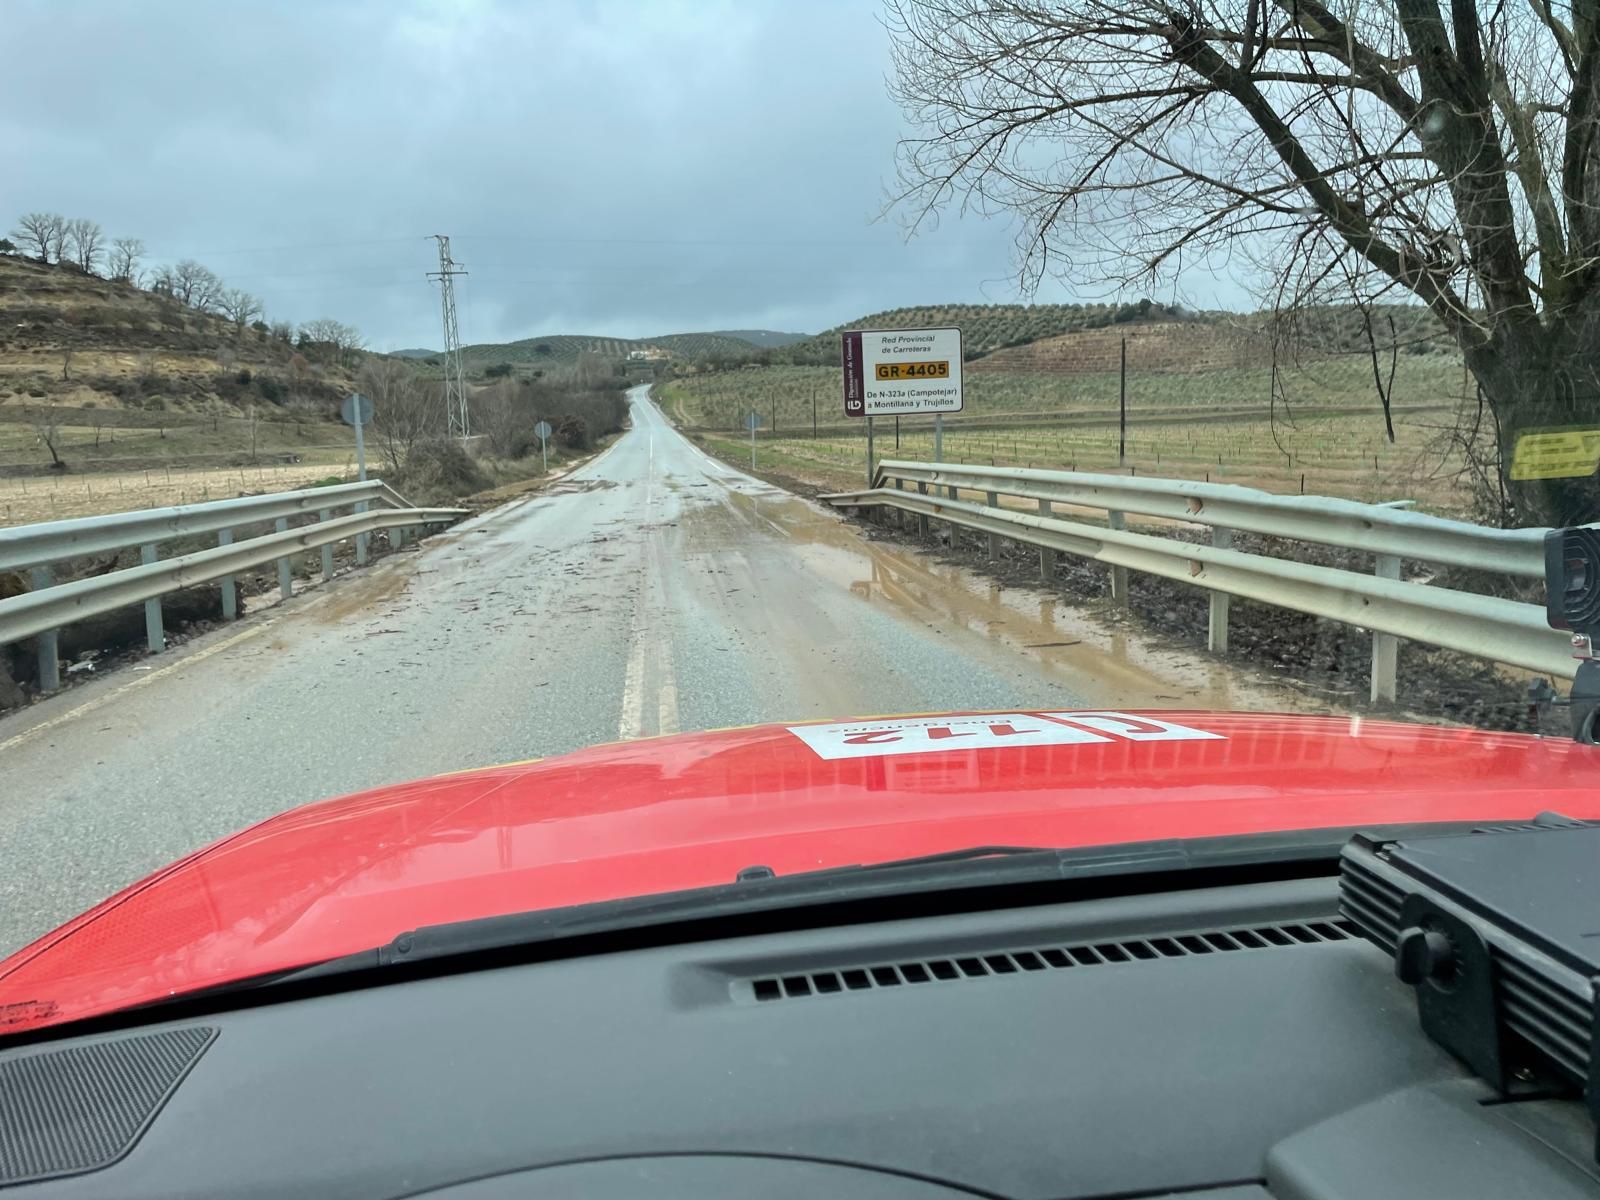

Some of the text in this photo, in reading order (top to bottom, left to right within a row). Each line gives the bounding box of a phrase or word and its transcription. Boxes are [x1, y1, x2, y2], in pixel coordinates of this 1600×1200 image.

[878, 363, 947, 378] GR-4405
[879, 390, 905, 398] N-323a
[924, 399, 954, 408] Trujillos
[843, 723, 1041, 744] 112
